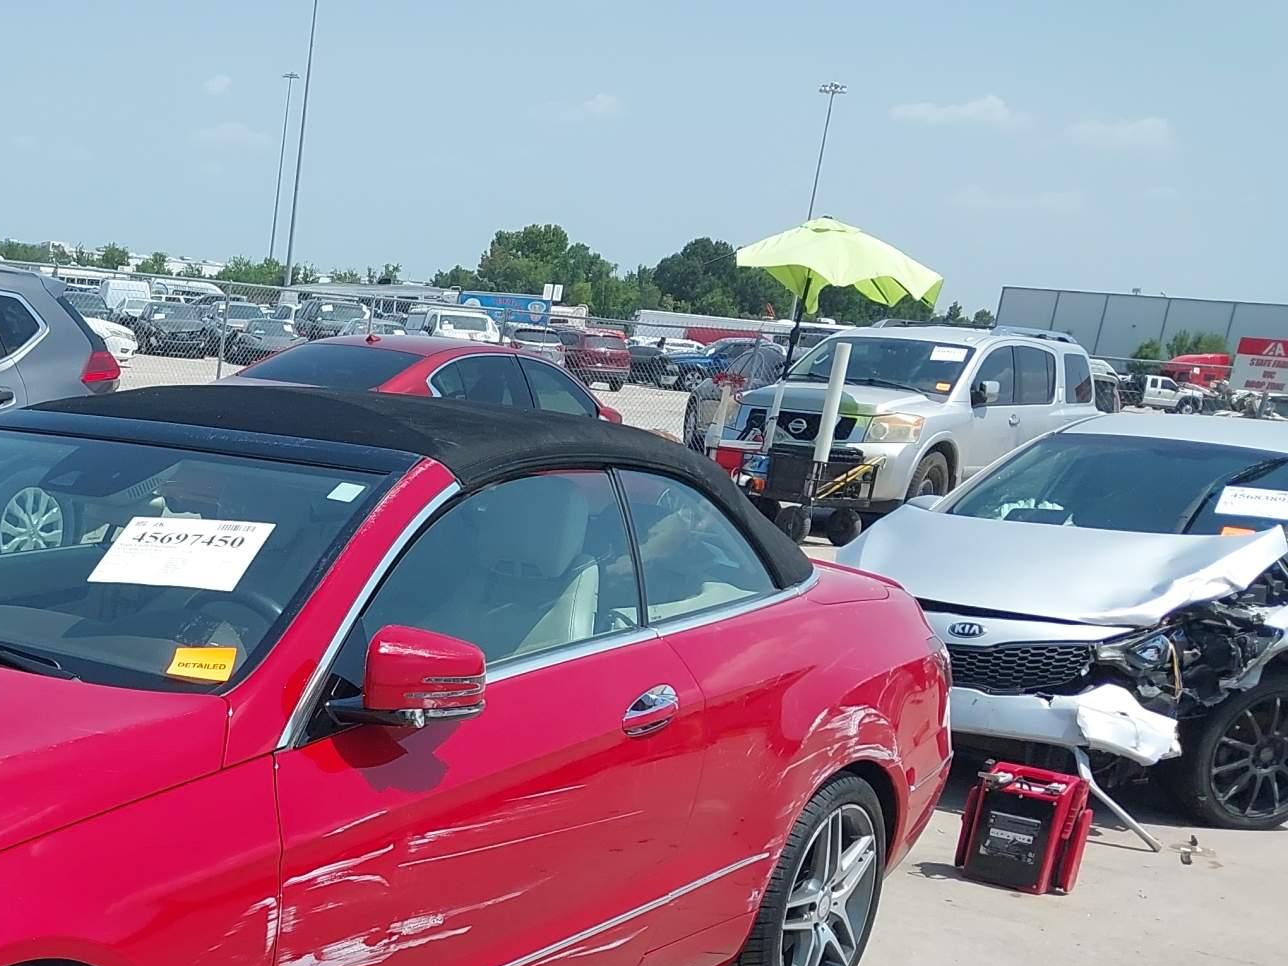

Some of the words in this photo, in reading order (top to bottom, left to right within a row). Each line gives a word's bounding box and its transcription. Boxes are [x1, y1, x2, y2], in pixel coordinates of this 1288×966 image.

[132, 531, 245, 549] 45697450
[954, 623, 980, 635] KIA
[177, 661, 227, 671] DETAILED
